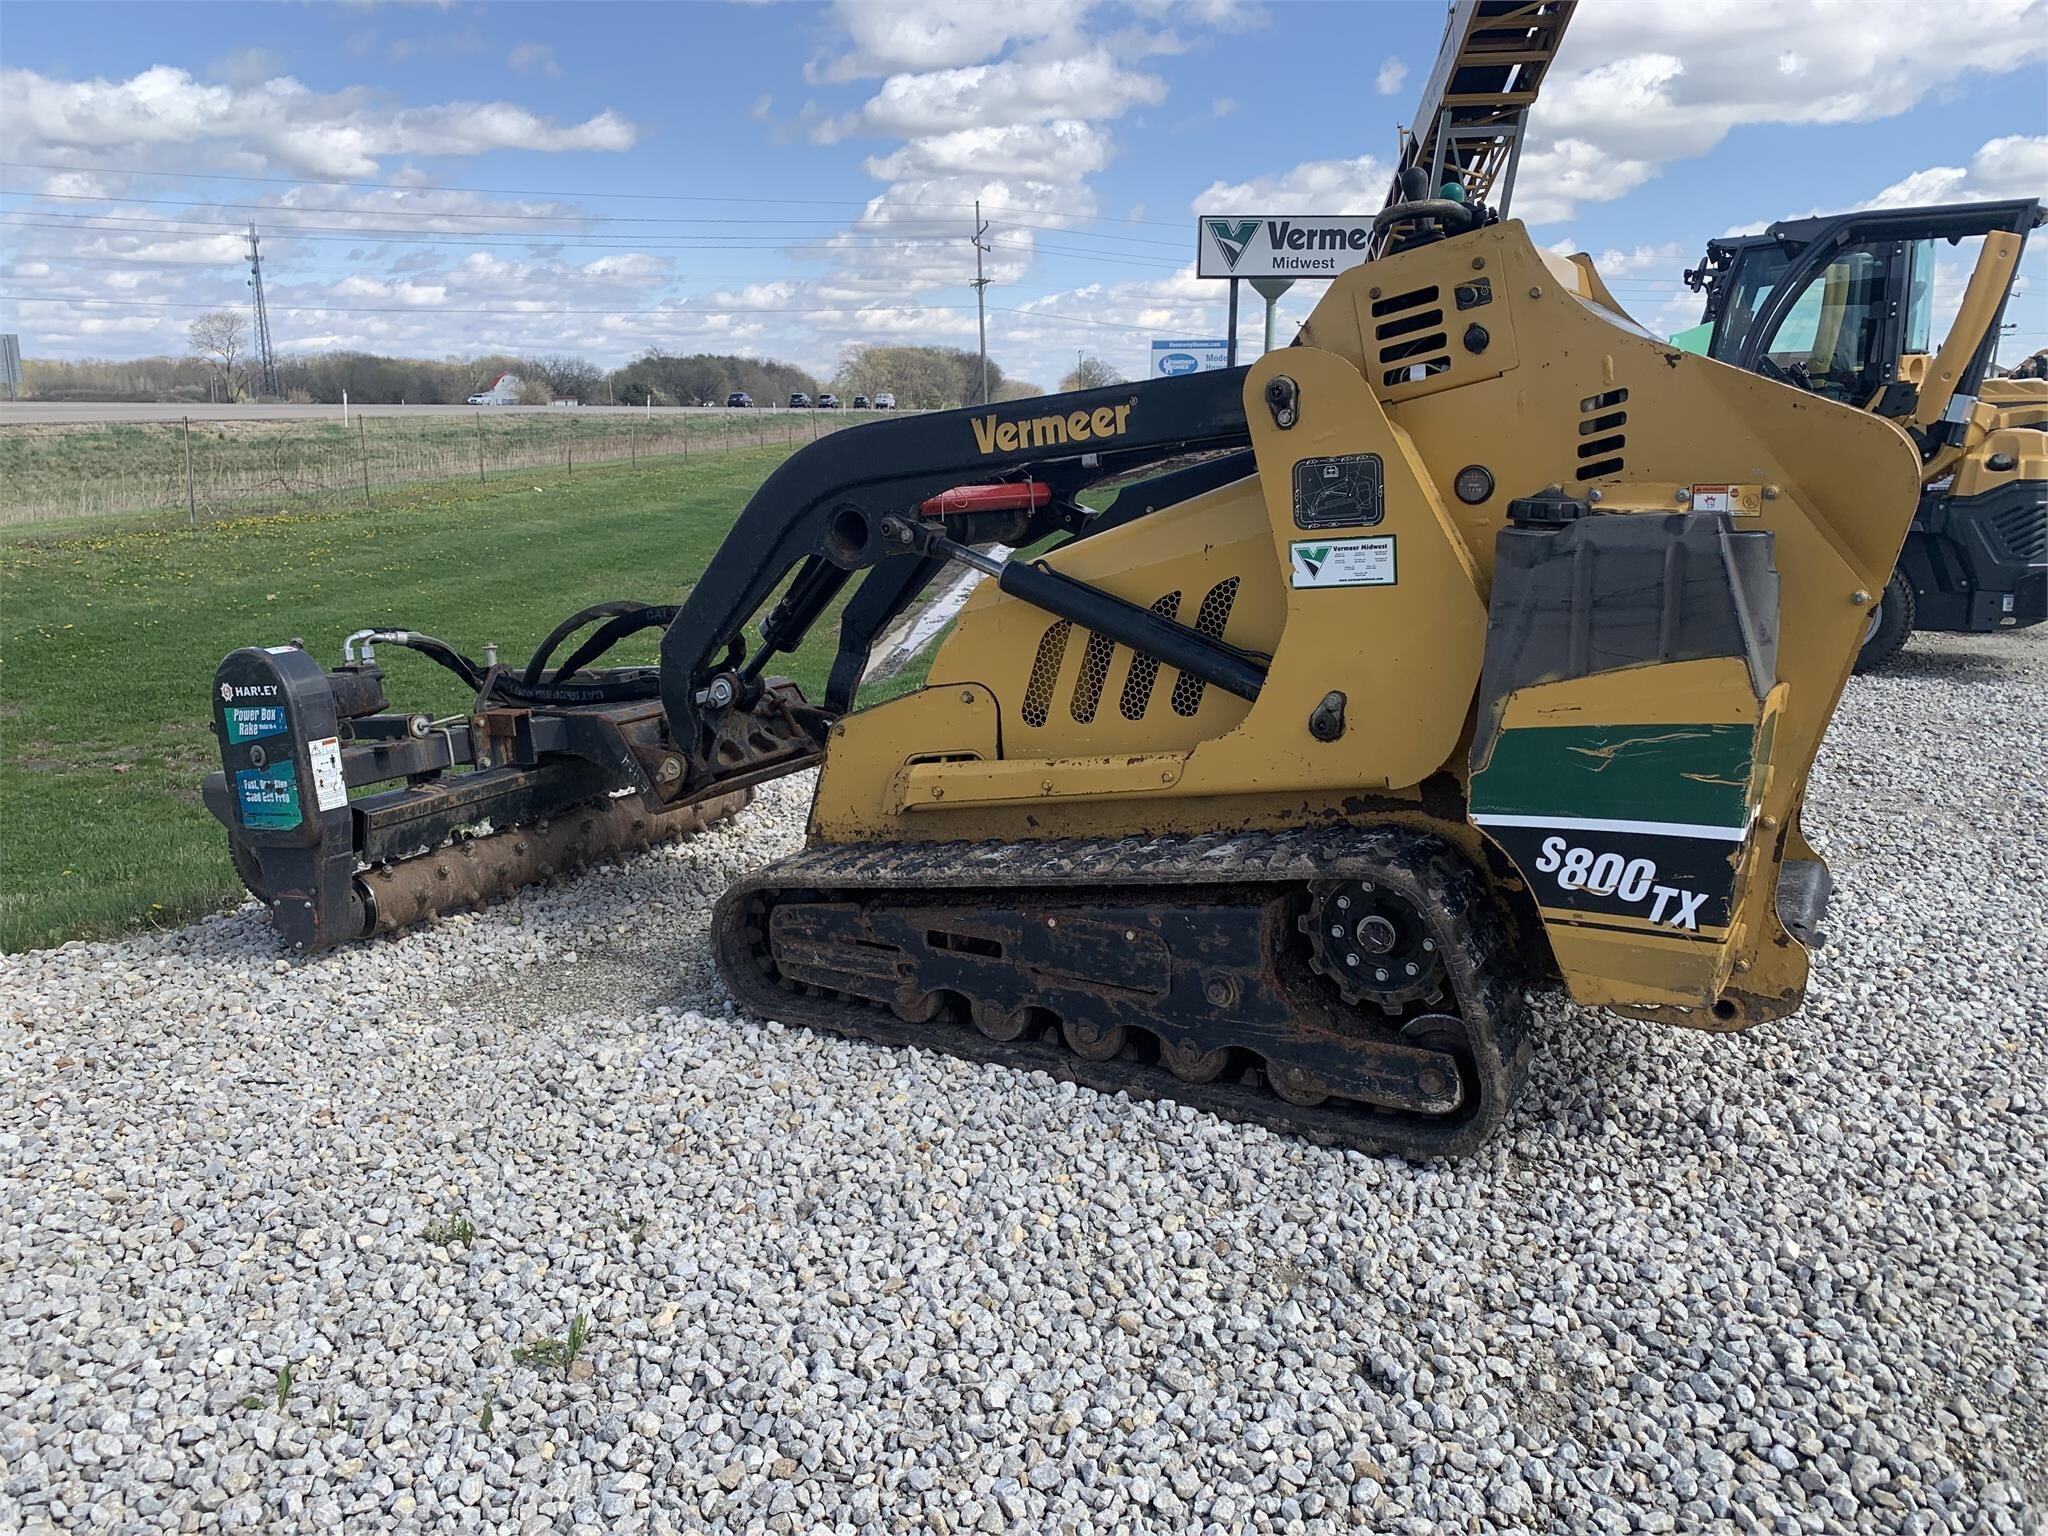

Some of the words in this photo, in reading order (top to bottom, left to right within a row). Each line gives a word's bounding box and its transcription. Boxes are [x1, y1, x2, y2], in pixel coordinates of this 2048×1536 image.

[1272, 257, 1335, 269] Midwest
[970, 403, 1131, 455] Vermeer
[235, 685, 278, 697] HARLEY
[233, 708, 260, 722] Power
[261, 708, 276, 721] Box
[239, 722, 259, 736] Rake
